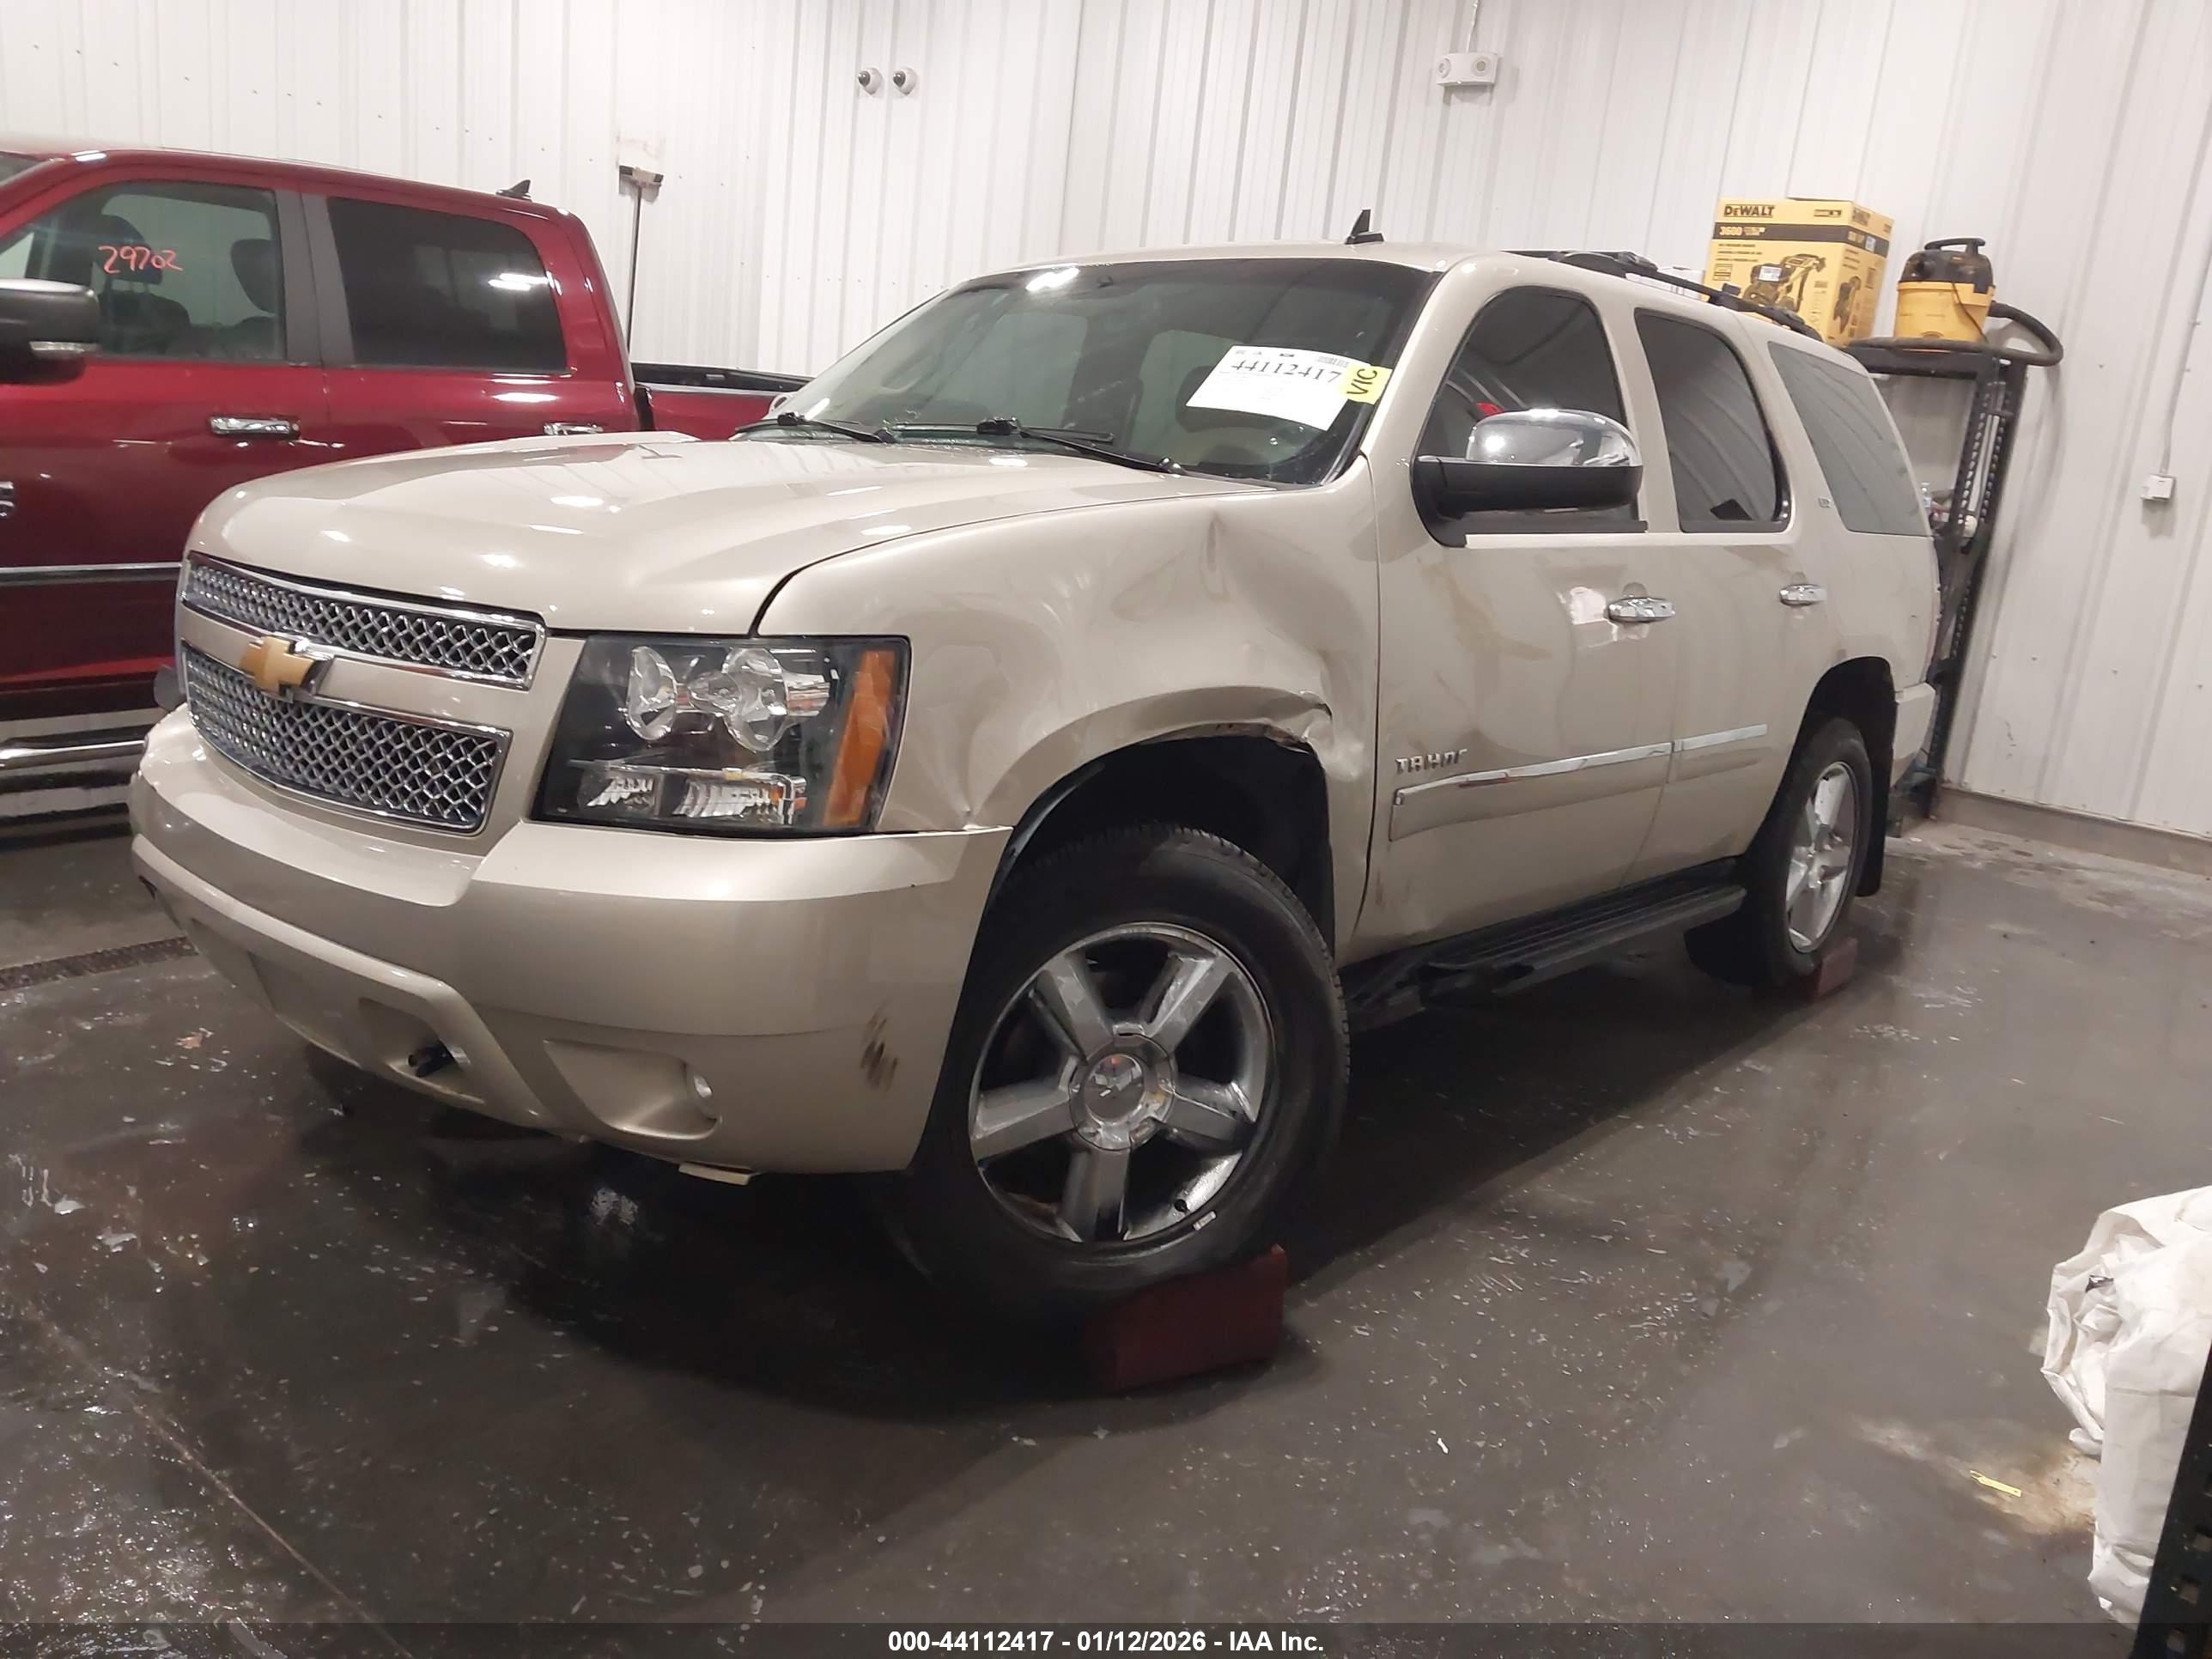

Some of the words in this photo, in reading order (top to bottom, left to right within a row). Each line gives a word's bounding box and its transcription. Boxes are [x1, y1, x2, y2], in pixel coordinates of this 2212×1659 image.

[98, 246, 184, 273] 29702
[1231, 359, 1342, 383] 44112417
[1346, 368, 1378, 397] VIC
